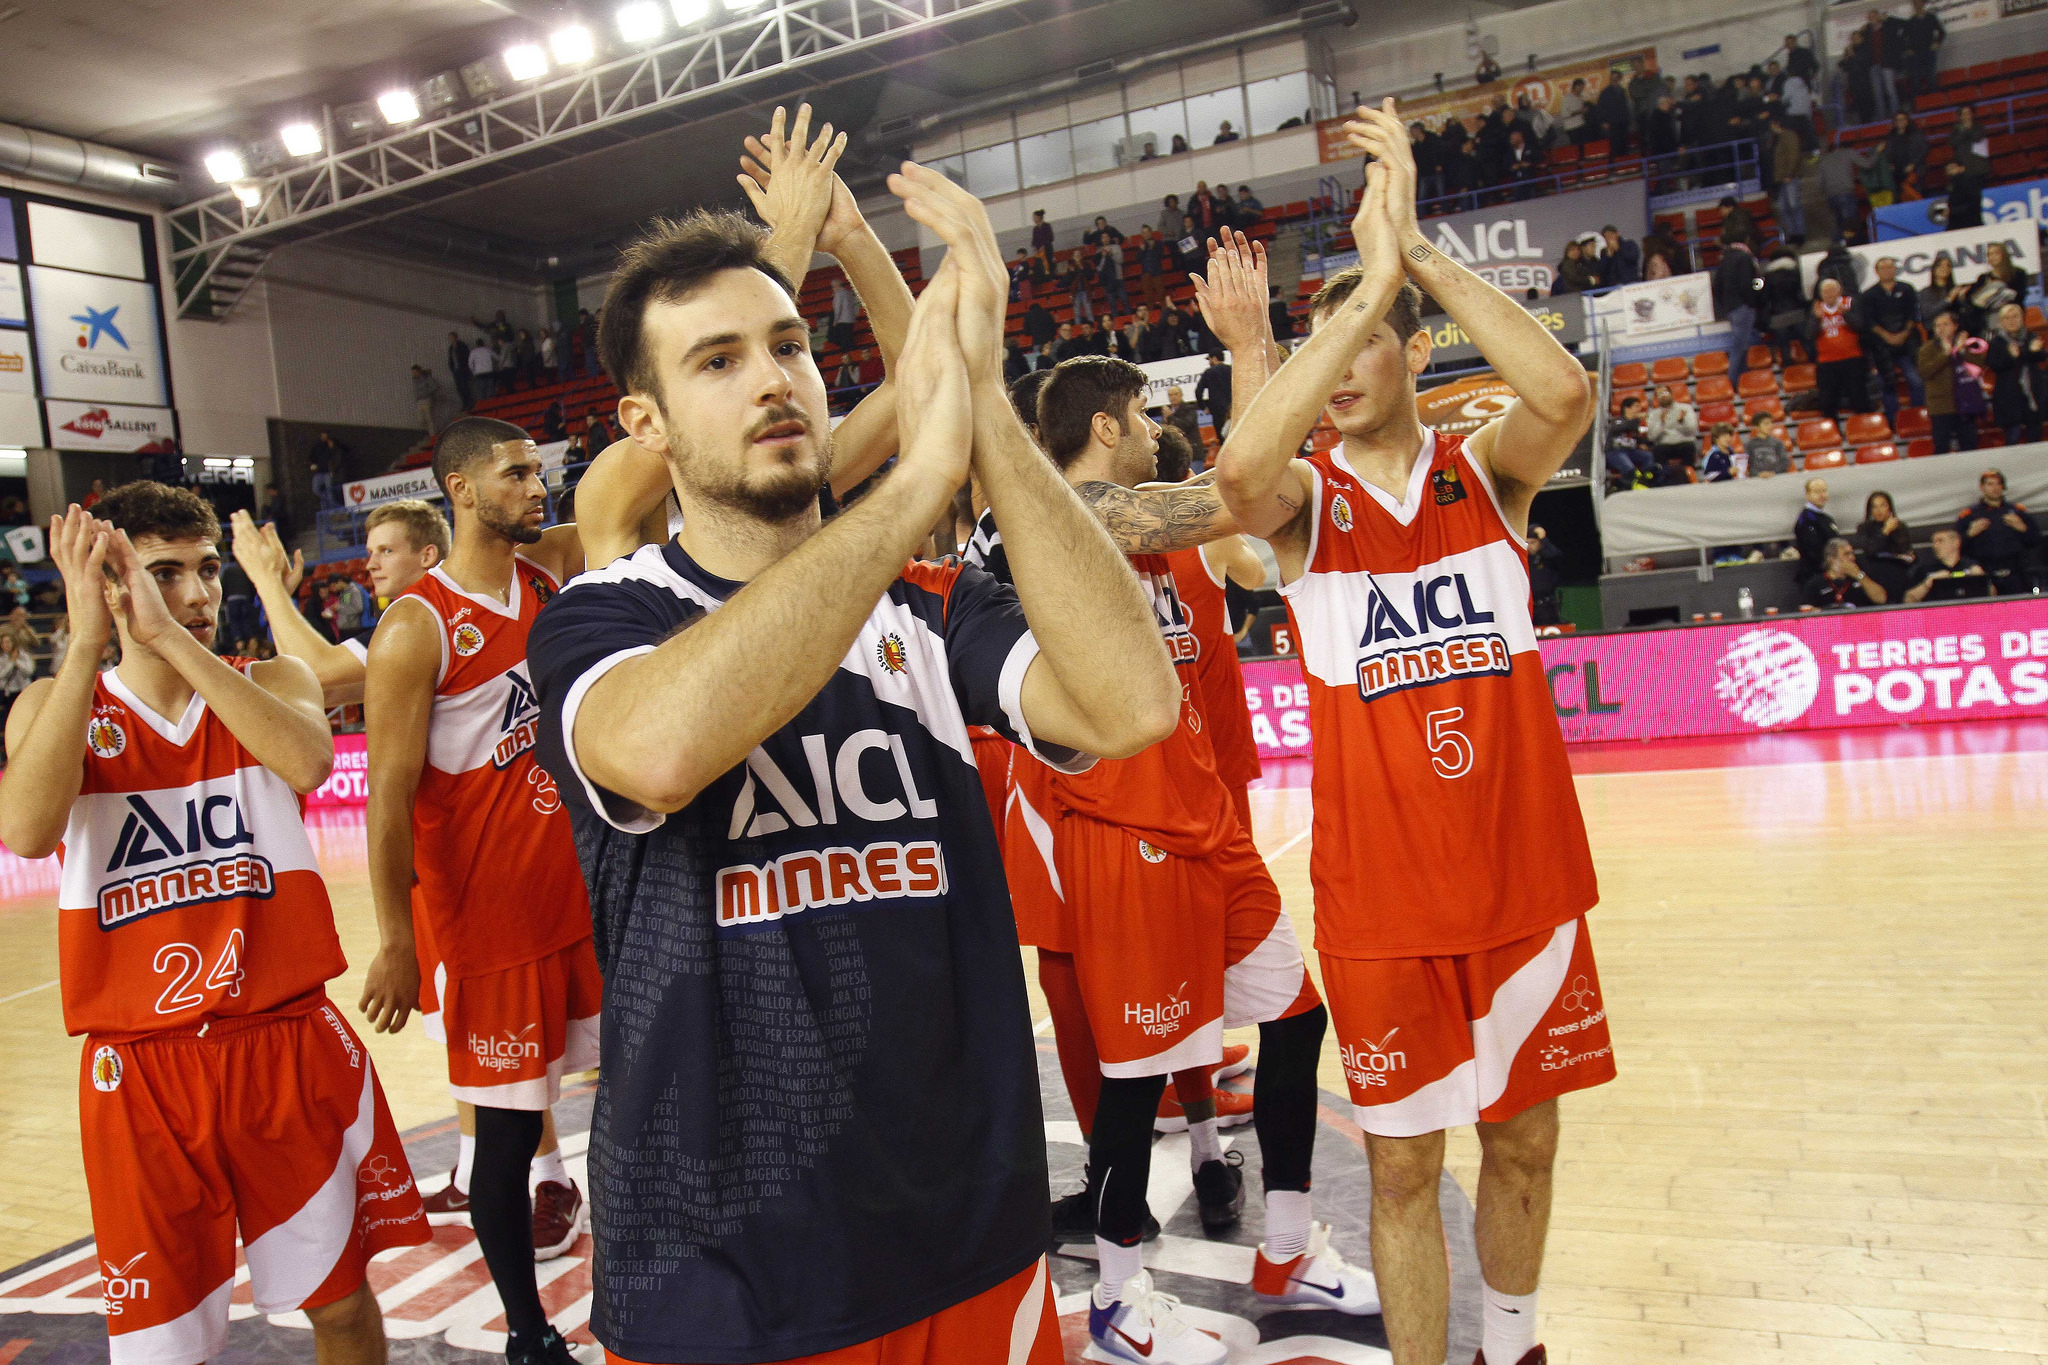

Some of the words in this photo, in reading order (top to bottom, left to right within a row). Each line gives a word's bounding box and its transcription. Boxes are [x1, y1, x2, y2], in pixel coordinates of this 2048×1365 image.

[1434, 219, 1543, 264] AICL
[60, 354, 145, 378] CaixaBank
[369, 480, 428, 501] MANRESA
[1360, 574, 1495, 648] AICL
[889, 632, 907, 662] ANRESA
[1275, 629, 1290, 654] 5
[1831, 634, 1986, 671] TERRES
[2000, 628, 2048, 660] DE
[1358, 637, 1510, 698] MANRESA
[1272, 683, 1310, 708] DE
[1833, 660, 2048, 716] POTAS
[1250, 709, 1311, 748] AS
[1426, 706, 1474, 779] 5
[728, 729, 939, 840] AICL
[106, 794, 255, 874] AICL
[100, 855, 274, 930] MANRESA
[716, 841, 949, 927] MNRES
[645, 917, 663, 932] TOT
[823, 937, 864, 958] SOM-HI,
[152, 927, 246, 1016] 24
[671, 962, 691, 974] BEN
[754, 961, 790, 979] SOM-HI
[828, 954, 867, 974] SOM-HI,
[830, 970, 871, 991] ANRESA,
[612, 993, 631, 1007] SOM
[756, 994, 793, 1011] MILLOR
[853, 985, 873, 1002] TOT
[765, 1027, 783, 1043] PER
[1142, 1019, 1180, 1038] viajes
[1548, 1021, 1580, 1037] neas
[477, 1055, 520, 1073] viajes
[745, 1054, 793, 1076] MANRESA!
[796, 1060, 837, 1077] SOM-HI,
[741, 1070, 776, 1088] SOM-HI
[778, 1077, 831, 1092] MANRESA!
[731, 1086, 762, 1101] MOLTA
[763, 1088, 784, 1104] JOIA
[653, 1102, 673, 1117] PER
[726, 1102, 765, 1121] EUROPA,
[775, 1104, 798, 1123] TOTS
[800, 1109, 821, 1125] BEN
[824, 1104, 855, 1121] UNITS
[742, 1118, 788, 1135] ANIMANT
[803, 1121, 843, 1141] NOSTRE
[795, 1138, 830, 1156] SOM-HI
[663, 1148, 677, 1164] DE
[677, 1153, 693, 1171] SER
[693, 1158, 707, 1173] LA
[708, 1152, 743, 1173] MILLOR
[797, 1154, 815, 1170] ARA
[629, 1164, 671, 1181] SOM-HI,
[717, 1171, 740, 1187] SOM
[744, 1166, 792, 1182] BAGENCS
[637, 1179, 685, 1199] LLENGUA,
[695, 1189, 718, 1205] AMB
[721, 1183, 756, 1201] MOLTA
[758, 1182, 783, 1198] JOIA
[682, 1201, 721, 1221] PORTEM
[722, 1201, 747, 1219] NOM
[749, 1199, 762, 1215] DE
[613, 1211, 658, 1227] EUROPA,
[667, 1211, 690, 1229] TOTS
[692, 1217, 710, 1235] BEN
[713, 1219, 744, 1237] UNITS
[643, 1227, 684, 1244] SOM-HI,
[626, 1244, 639, 1258] EL
[605, 1259, 645, 1275] NOSTRE
[628, 1275, 656, 1291] FORT
